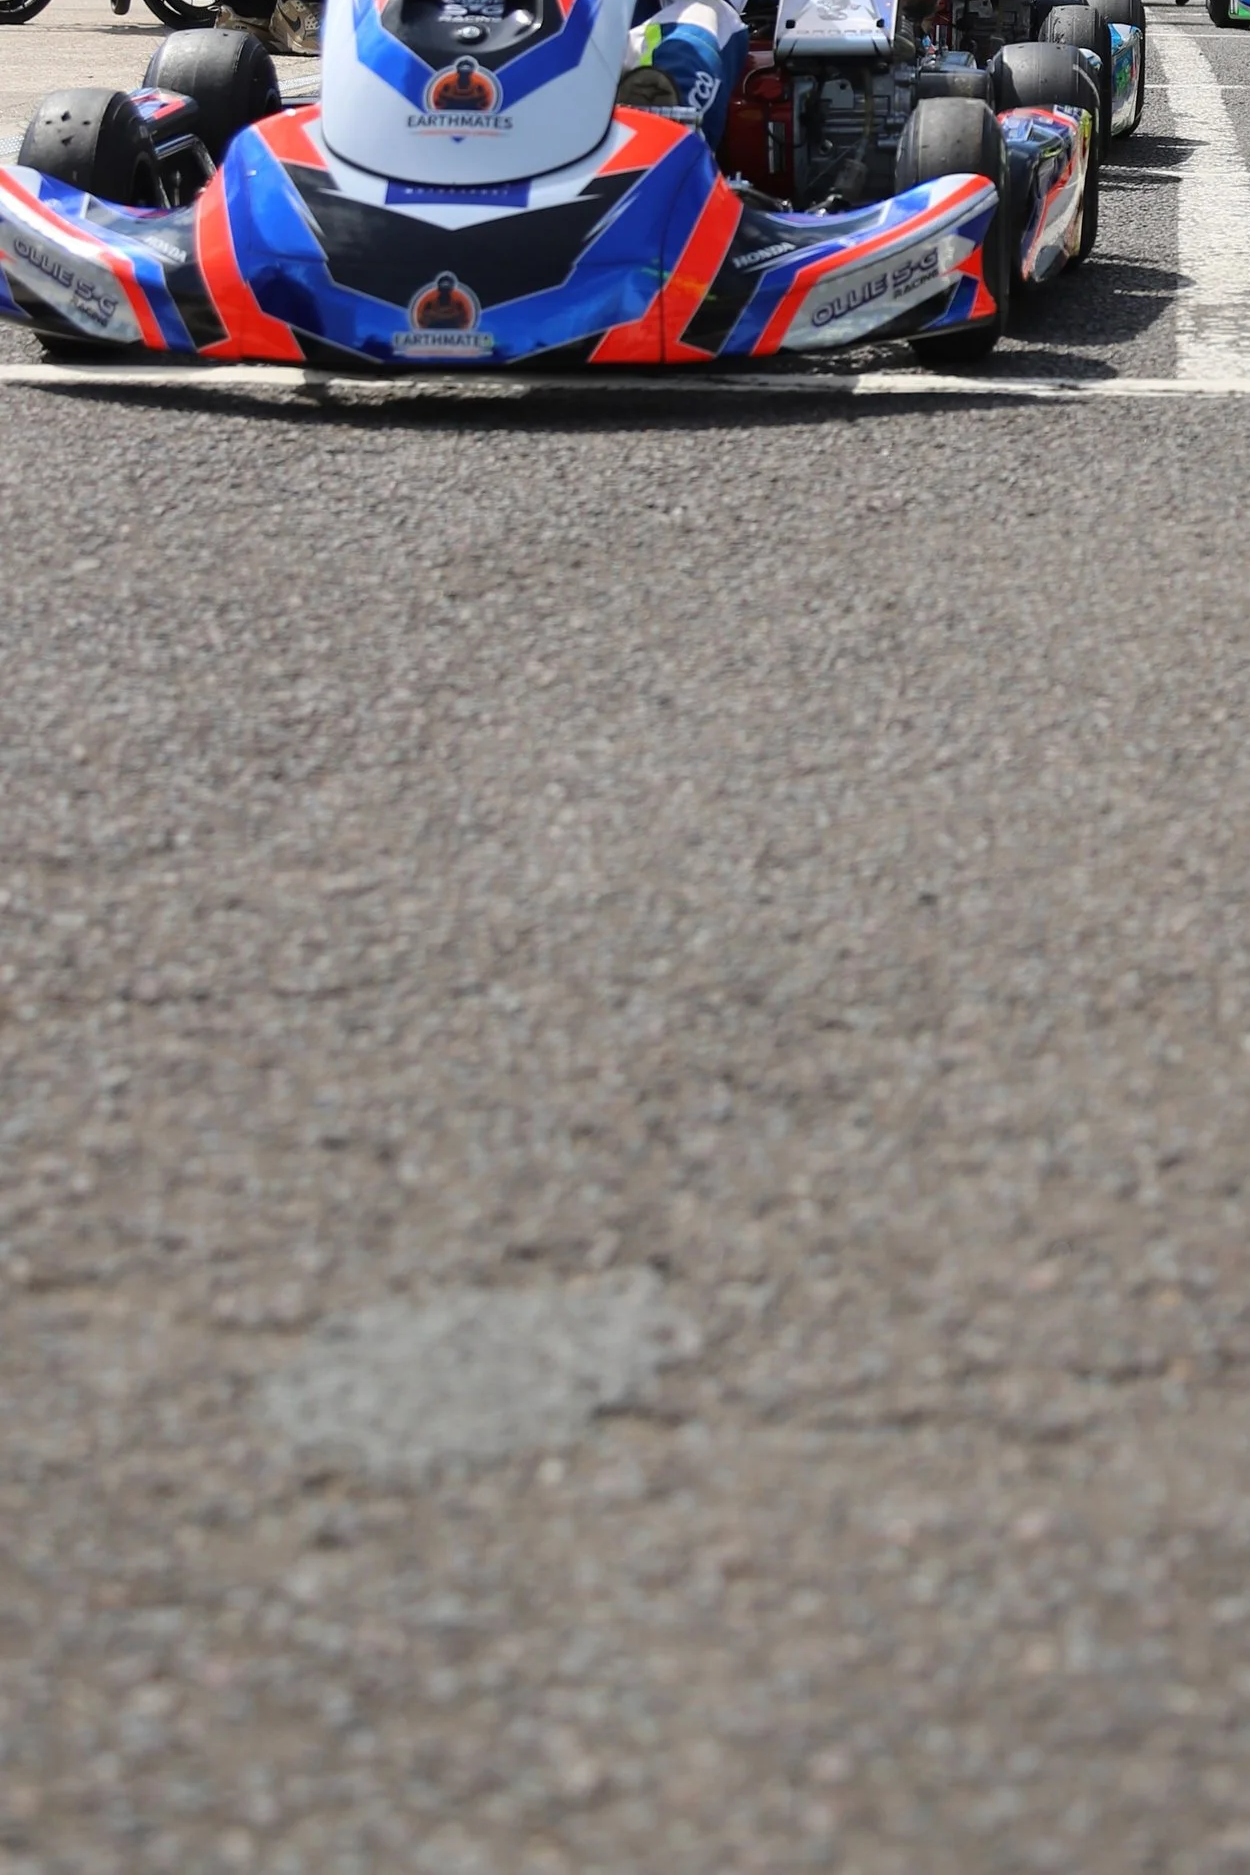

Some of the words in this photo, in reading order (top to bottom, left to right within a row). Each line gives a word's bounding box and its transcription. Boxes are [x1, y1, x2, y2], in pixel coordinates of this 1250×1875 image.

[407, 115, 514, 130] EARTHMATES
[14, 237, 75, 288] OLLIE
[143, 235, 188, 264] HONDA
[731, 241, 797, 268] HONDA
[892, 268, 941, 300] RACING
[812, 273, 888, 327] OLLIE
